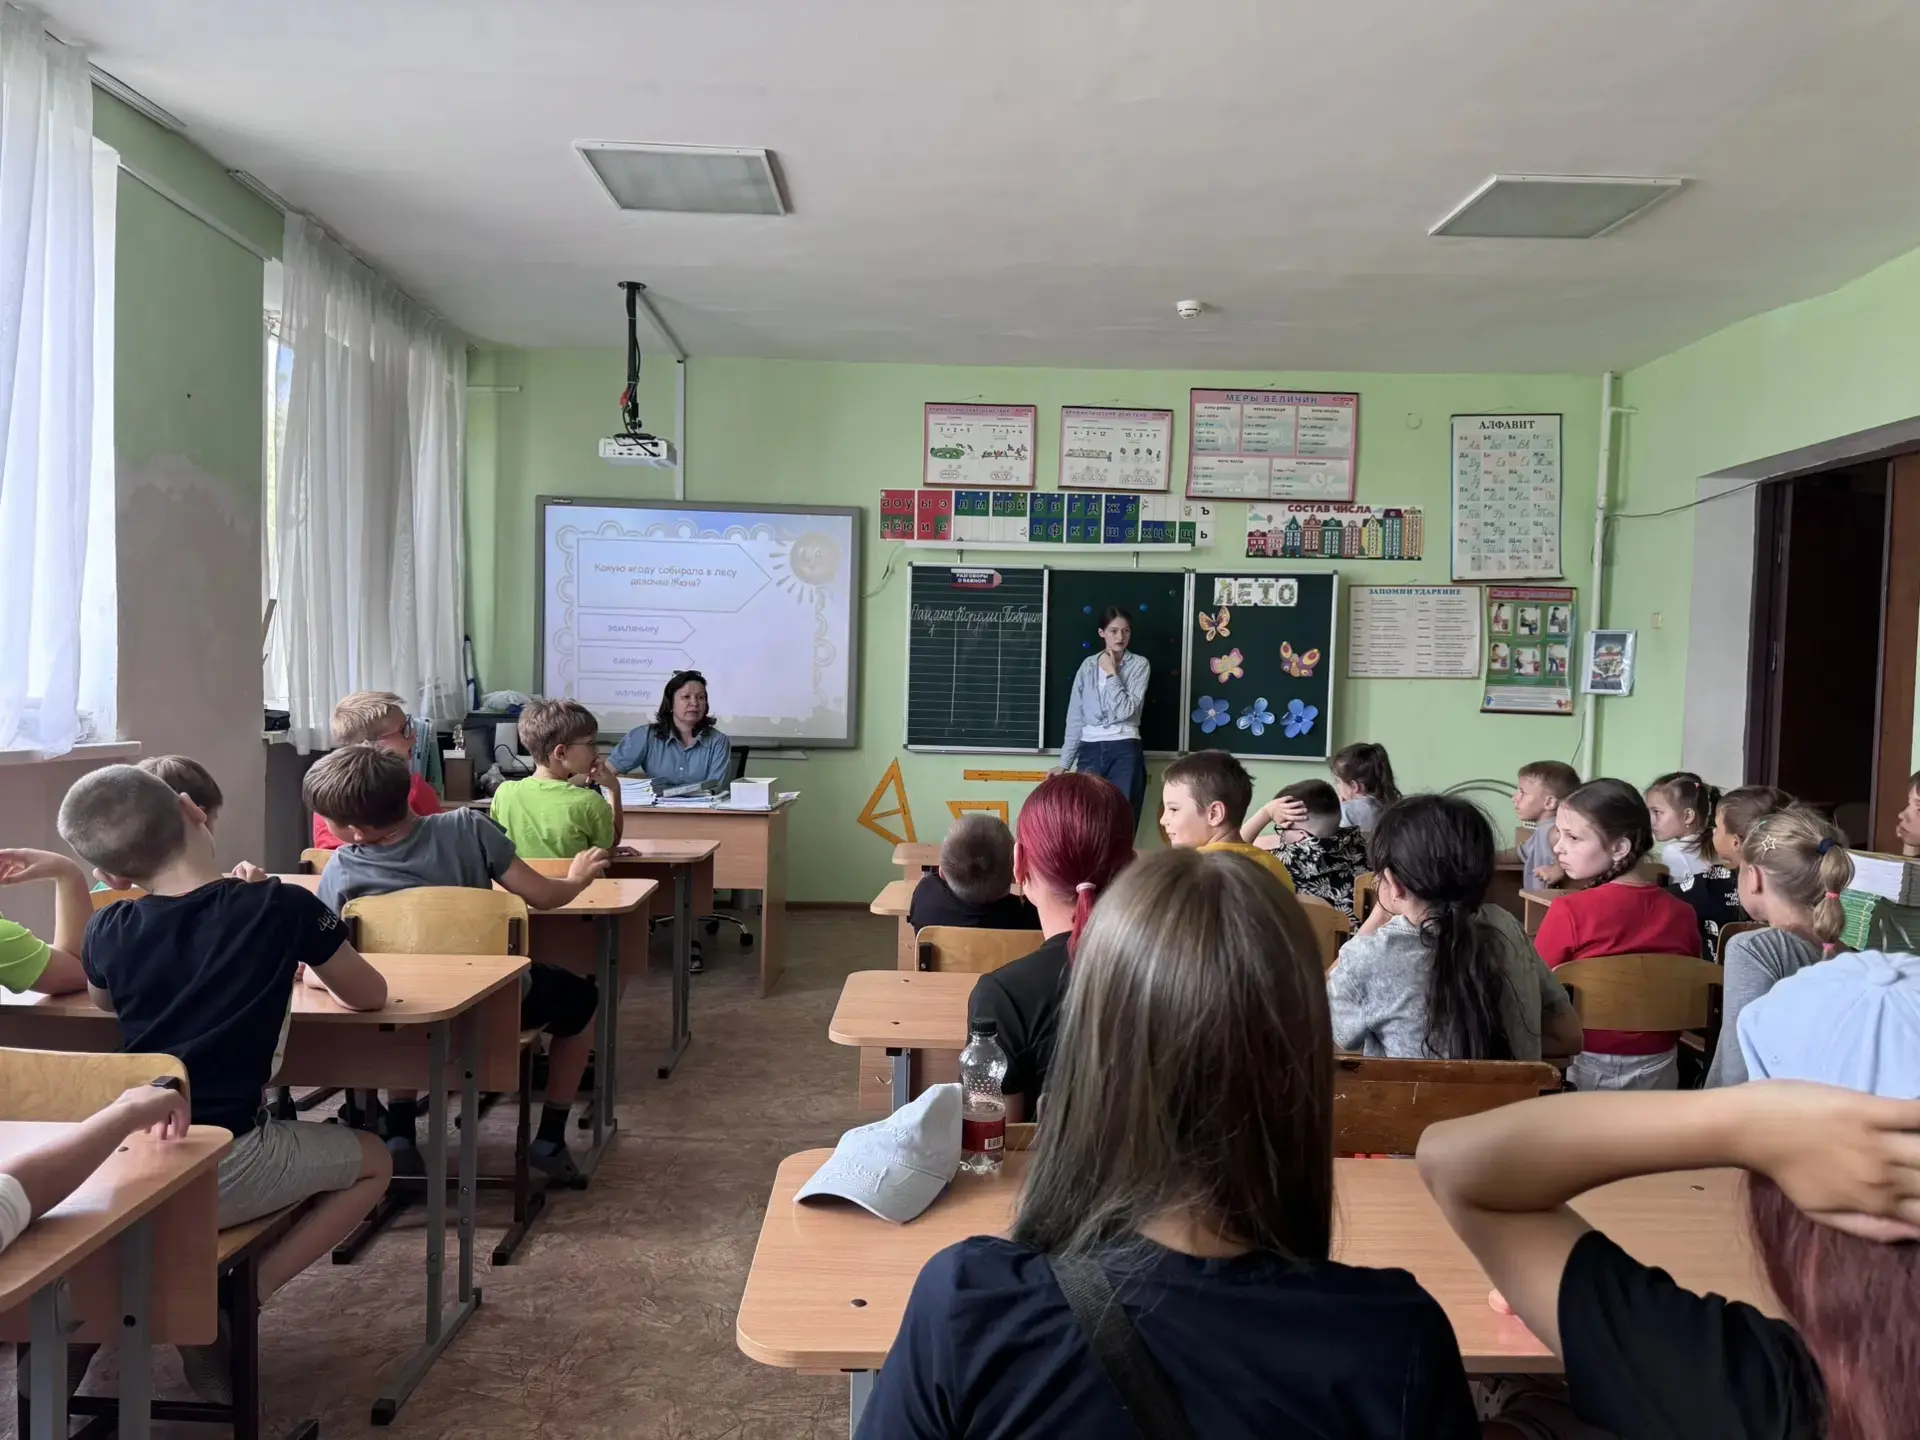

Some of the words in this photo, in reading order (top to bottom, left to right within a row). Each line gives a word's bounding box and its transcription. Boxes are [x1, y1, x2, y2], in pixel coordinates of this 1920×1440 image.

[1225, 393, 1259, 403] МЕРЫ
[1263, 394, 1318, 405] ВЕЛИЧИН
[1478, 419, 1535, 430] АЛФАВИТ
[1287, 503, 1331, 514] СОСТАВ
[1332, 504, 1373, 515] ЧИСЛА
[594, 562, 626, 575] Какую
[628, 566, 655, 578] ягоду
[658, 565, 703, 578] собирала
[714, 568, 738, 579] лесу
[630, 577, 669, 588] девочка
[1217, 579, 1295, 605] ЛЕТО
[1368, 588, 1413, 597] ЗАПОМНИ
[1413, 588, 1463, 597] УДАРЕНИЕ
